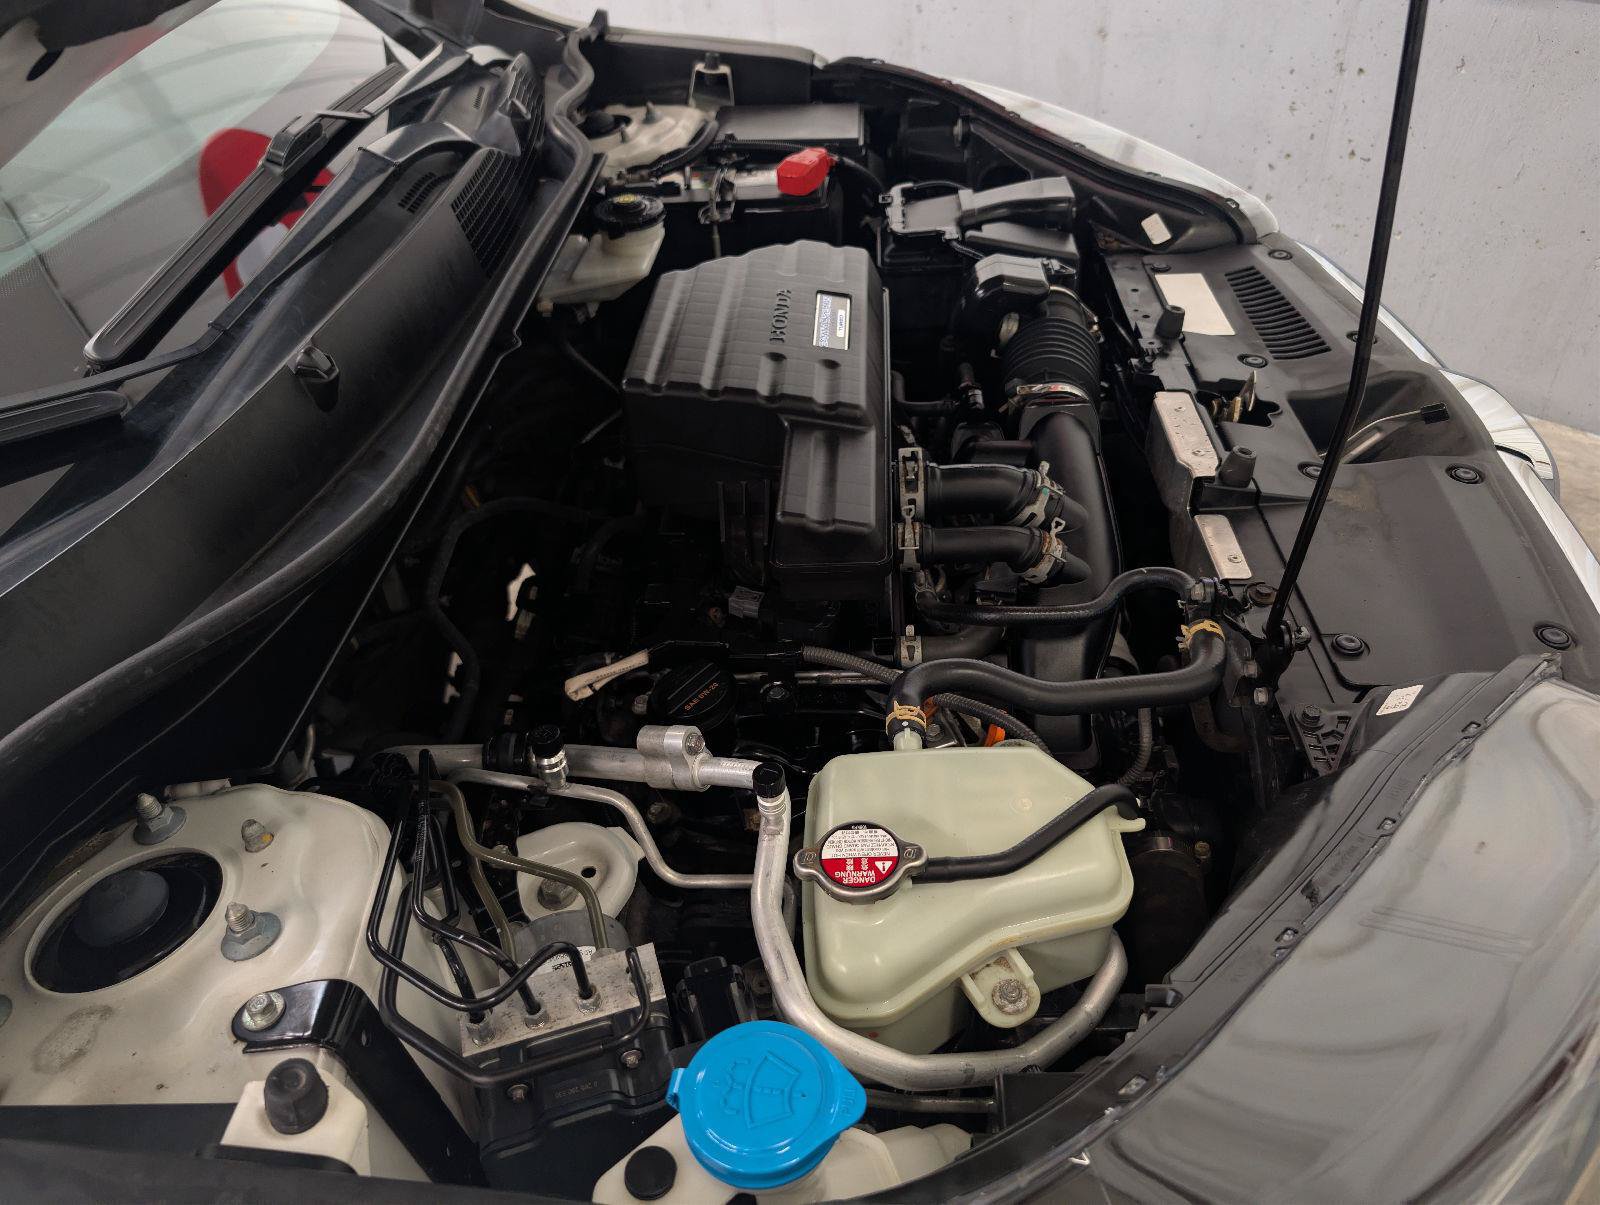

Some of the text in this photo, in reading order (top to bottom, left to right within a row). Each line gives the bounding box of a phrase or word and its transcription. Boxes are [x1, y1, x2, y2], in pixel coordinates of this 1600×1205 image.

[769, 289, 792, 343] HONDA
[684, 682, 718, 710] SAE 0W-20
[834, 870, 876, 878] WARNUNG
